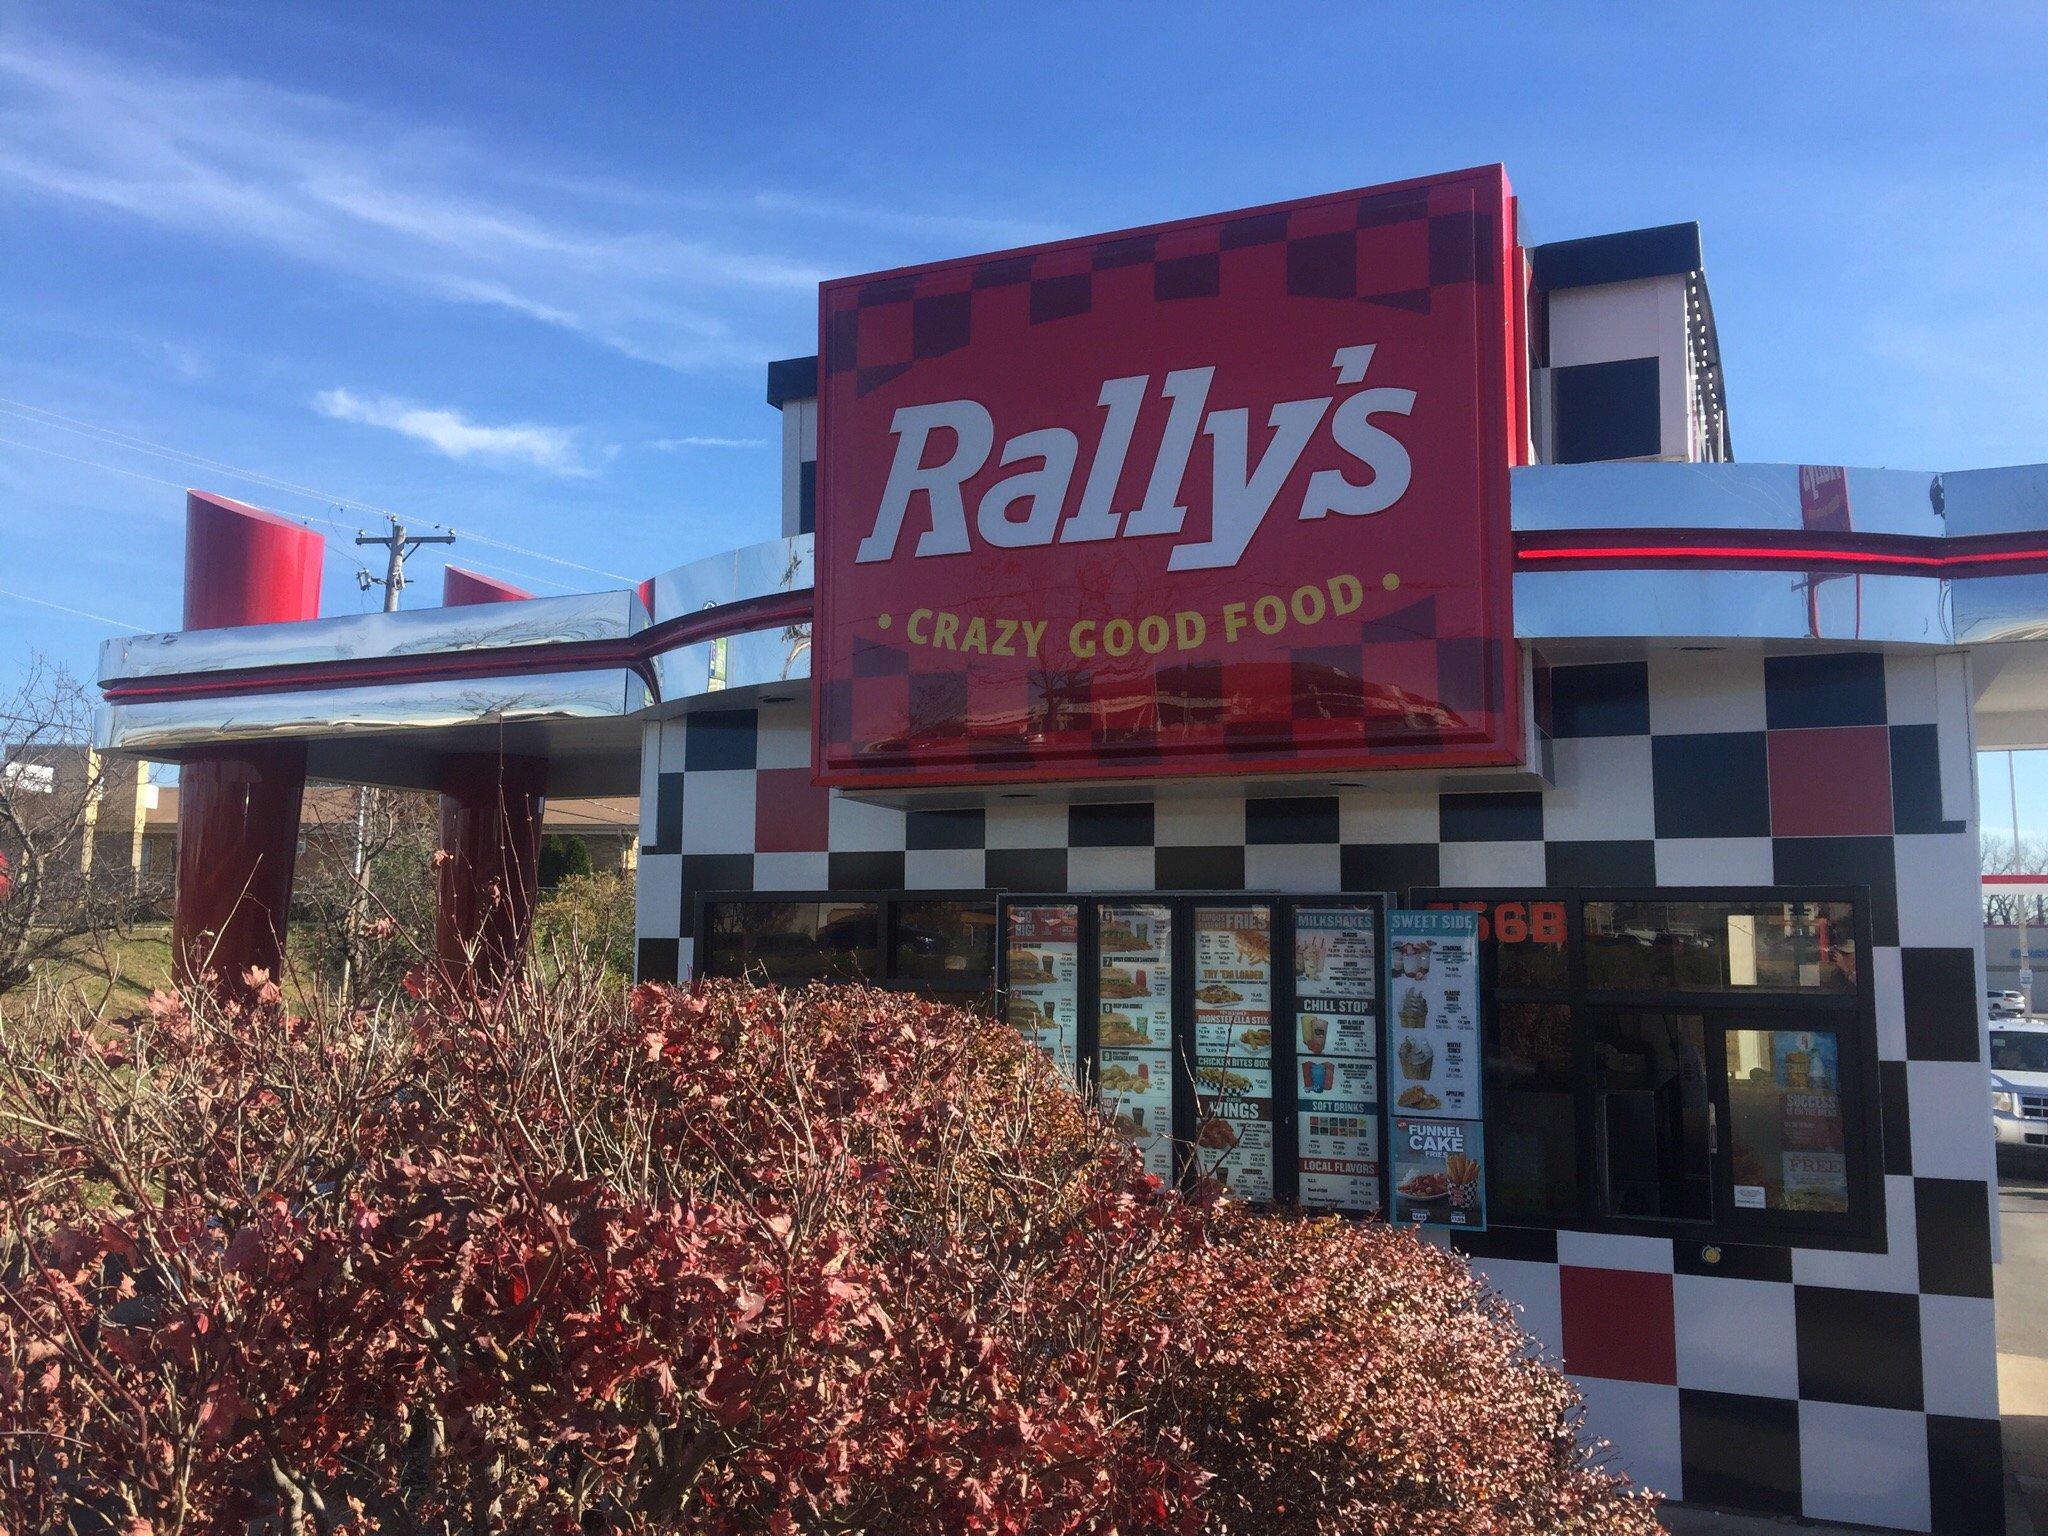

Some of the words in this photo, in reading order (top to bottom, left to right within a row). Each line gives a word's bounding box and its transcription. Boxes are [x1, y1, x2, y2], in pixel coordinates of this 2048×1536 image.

[855, 344, 1418, 571] Rally's
[907, 608, 1048, 659] CRAZY
[1069, 610, 1207, 659] GOOD
[1224, 573, 1364, 643] FOOD
[1298, 915, 1373, 928] MILKSHAKES
[1392, 915, 1438, 928] SWEET
[1442, 915, 1472, 928] SIDE
[1203, 970, 1218, 979] TRY
[1235, 970, 1264, 979] LOADED
[1303, 999, 1336, 1012] CHILL
[1338, 1001, 1368, 1013] STOP
[1251, 1017, 1269, 1025] STIX
[1232, 1058, 1253, 1067] BITES
[1254, 1059, 1269, 1068] BOX
[1209, 1101, 1259, 1119] WINGS
[1312, 1101, 1333, 1111] SOFT
[1334, 1102, 1365, 1112] DRINKS
[1408, 1125, 1463, 1137] FUNNEL
[1409, 1135, 1464, 1152] CAKE
[1304, 1161, 1333, 1172] LOCAL
[1334, 1162, 1375, 1174] FLAVORS
